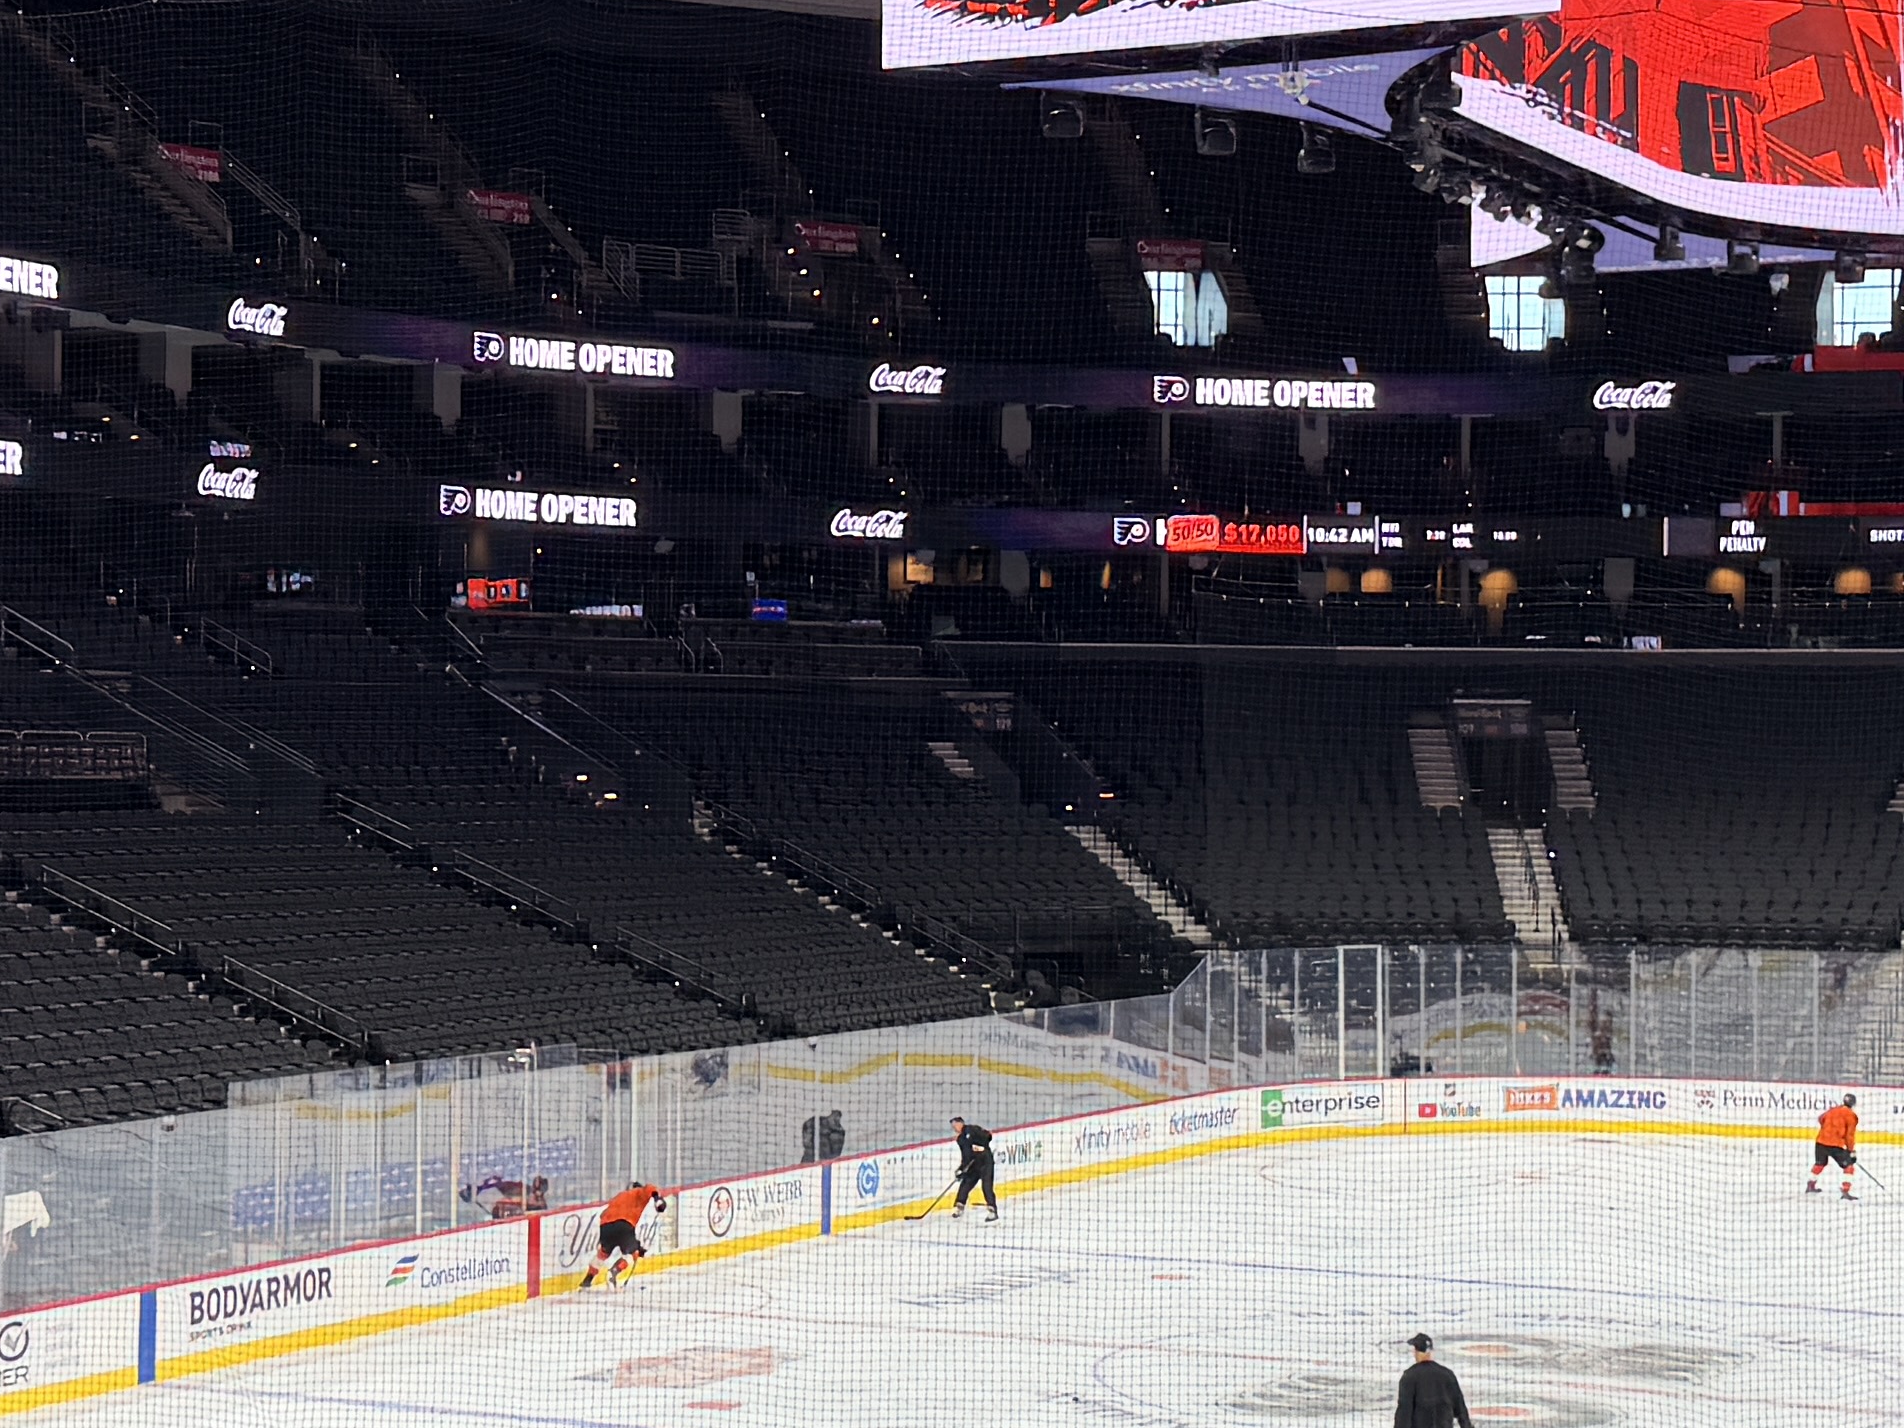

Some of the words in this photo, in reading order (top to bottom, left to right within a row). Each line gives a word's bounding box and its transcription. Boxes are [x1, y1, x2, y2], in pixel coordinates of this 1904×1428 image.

[228, 297, 289, 337] Coca-Cola
[509, 336, 576, 370] HOME
[578, 342, 675, 378] OPENER
[869, 363, 948, 395] Coca-Cola
[1195, 376, 1270, 407] HOME
[1273, 379, 1376, 408] OPENER
[1592, 380, 1677, 409] Coca-Cola
[197, 463, 259, 500] Coca-Cola
[475, 488, 537, 522] HOME
[539, 493, 637, 527] OPENER
[830, 509, 909, 539] Coca-Cola
[1307, 528, 1348, 544] 10:42
[1350, 527, 1375, 544] AM
[1719, 536, 1767, 552] PENALTY
[1268, 1091, 1381, 1117] enterprise
[1440, 1102, 1482, 1117] YouTube
[1561, 1088, 1667, 1110] AMAZING
[1722, 1088, 1764, 1110] Penn
[1169, 1106, 1240, 1135] ticketmaster
[419, 1256, 512, 1290] Constellation
[188, 1266, 333, 1326] BODYARMOR
